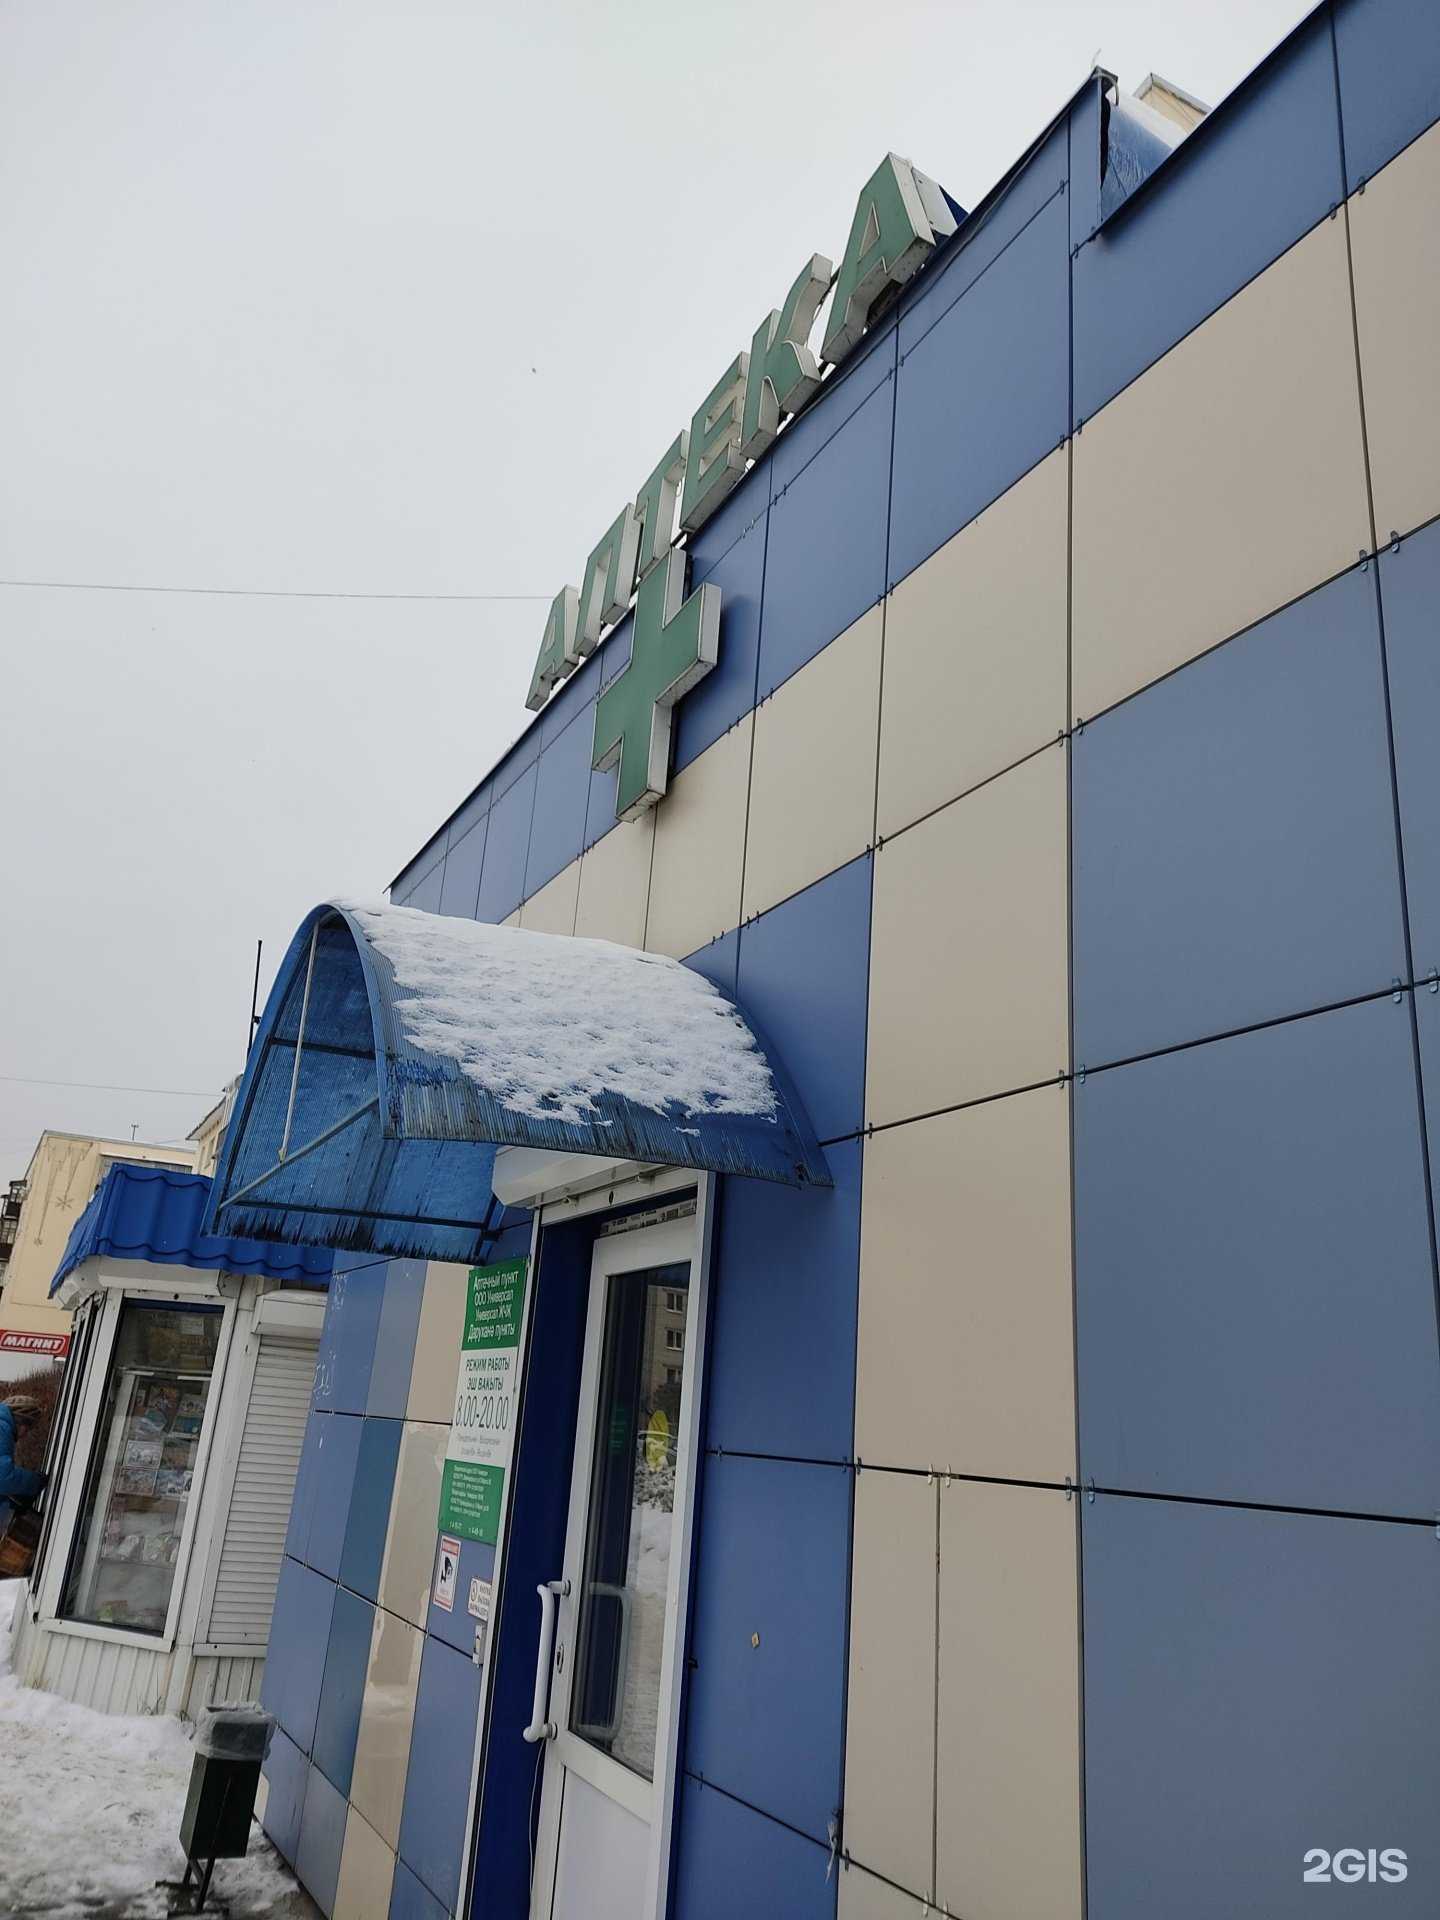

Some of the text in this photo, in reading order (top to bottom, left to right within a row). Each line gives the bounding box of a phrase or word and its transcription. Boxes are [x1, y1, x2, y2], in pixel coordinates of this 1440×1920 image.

[525, 152, 936, 711] АПТЕКА
[474, 1271, 519, 1291] Аптечный пункт
[474, 1289, 514, 1306] ООО Универсал
[475, 1307, 499, 1322] Универсал
[3, 1336, 62, 1350] МАГНИТ
[465, 1356, 511, 1371] РЕЖИМ РАБОТЫ
[455, 1394, 509, 1430] 8.00-20.00
